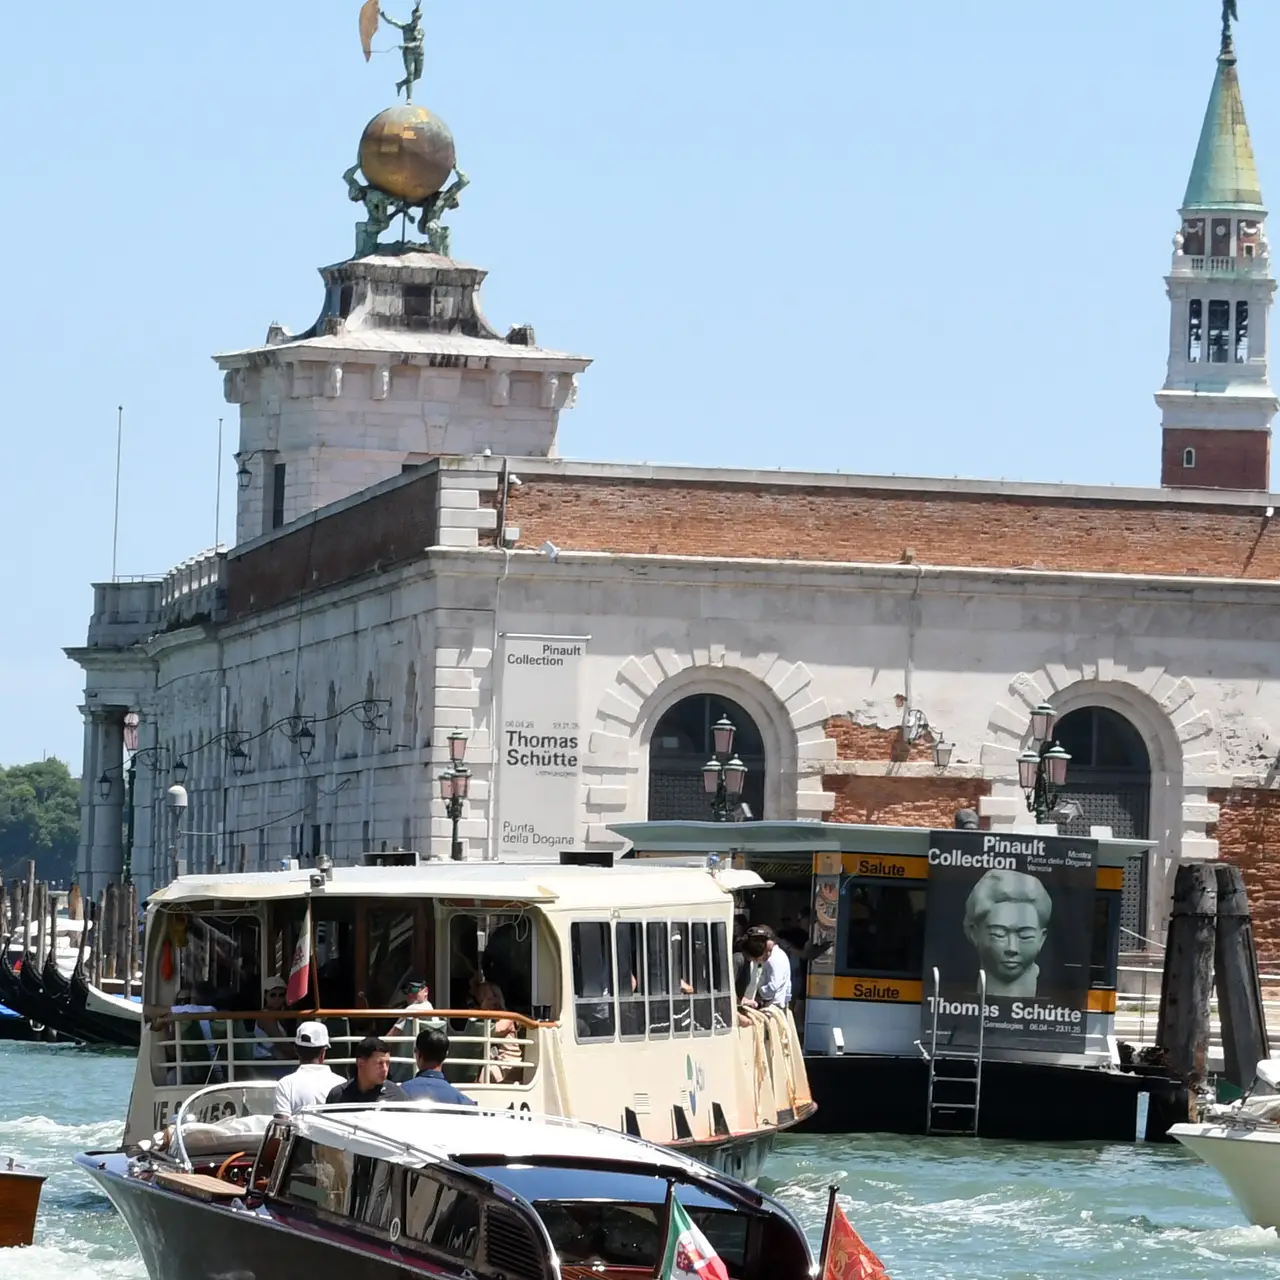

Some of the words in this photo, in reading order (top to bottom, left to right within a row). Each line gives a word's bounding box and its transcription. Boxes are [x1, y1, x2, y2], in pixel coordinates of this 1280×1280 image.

[542, 644, 582, 656] Pinault
[507, 653, 564, 666] Collection
[505, 730, 578, 749] Thomas
[506, 748, 578, 767] Schütte
[503, 820, 535, 833] Punta
[502, 832, 529, 844] della
[532, 833, 575, 847] Dogana
[983, 836, 1046, 856] Pinault
[928, 848, 1017, 870] Collection
[1027, 856, 1047, 864] Punta
[859, 860, 905, 877] Salute
[853, 983, 900, 999] Salute
[927, 996, 1000, 1018] Thomas
[1011, 1002, 1082, 1023] Schütte
[153, 1101, 169, 1130] VE
